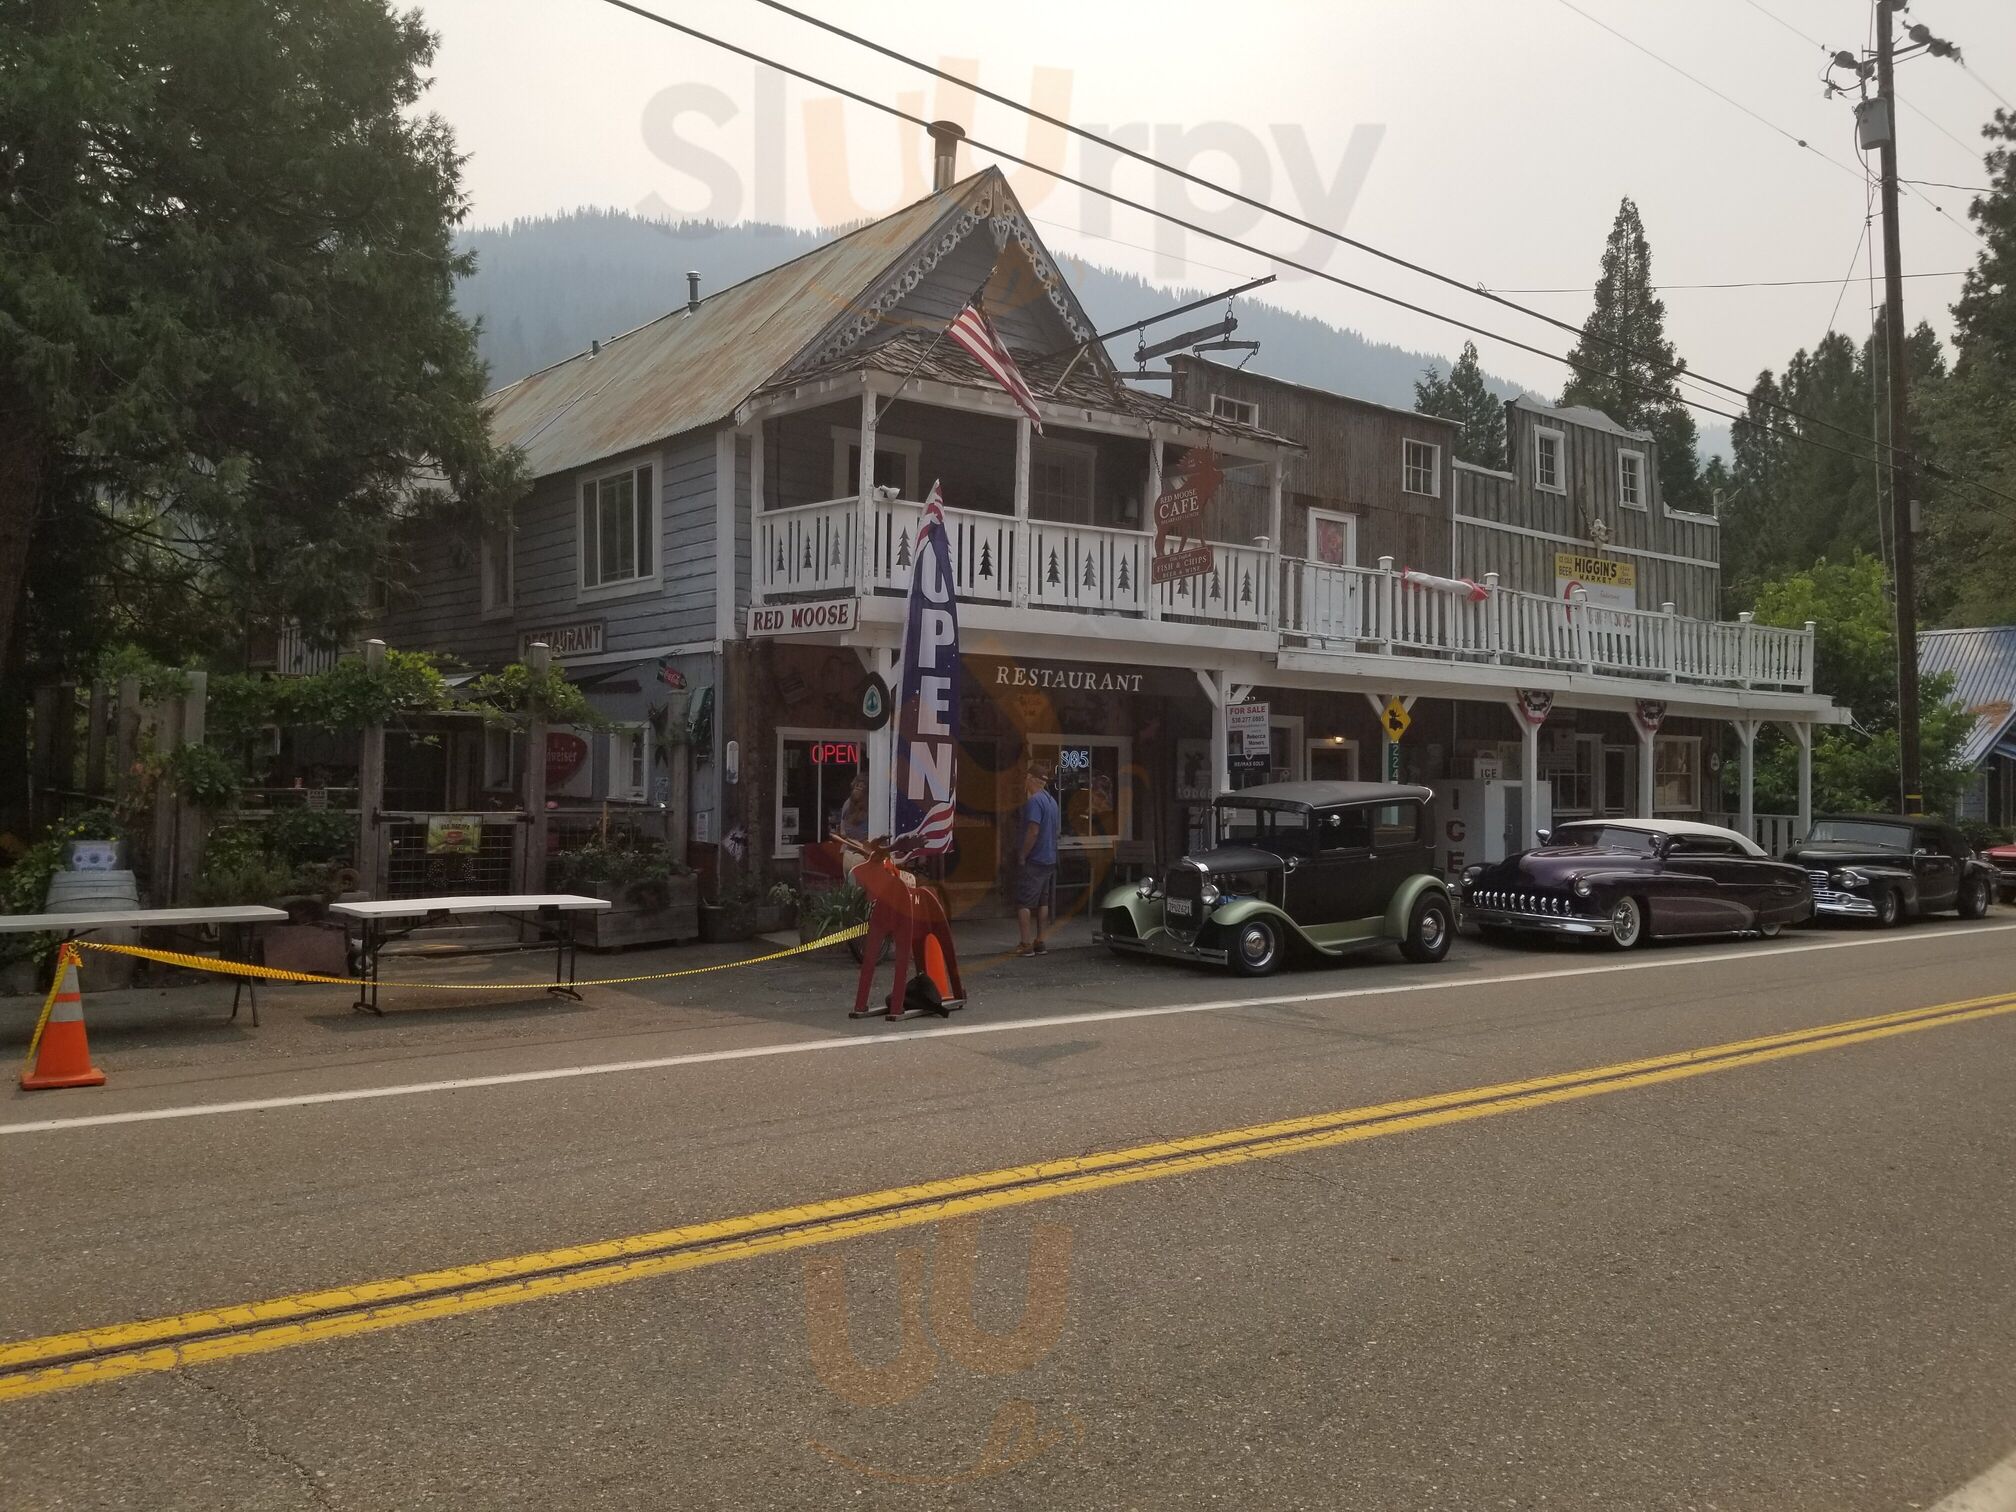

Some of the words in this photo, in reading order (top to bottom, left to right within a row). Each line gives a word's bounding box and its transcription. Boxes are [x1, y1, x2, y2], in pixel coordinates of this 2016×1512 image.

[1160, 495, 1173, 504] RED
[1173, 488, 1197, 501] MOOSE
[1159, 496, 1199, 519] CAFE
[1157, 562, 1173, 573] FISH
[1184, 555, 1207, 567] CHIPS
[1574, 557, 1617, 578] HIGGIN'S
[1580, 574, 1612, 584] MARKET
[753, 611, 784, 630] RED
[791, 604, 849, 628] MOOSE
[907, 541, 956, 803] OPEN
[995, 666, 1144, 692] RESTAURANT
[1230, 707, 1245, 715] FOR
[1247, 706, 1265, 714] SALE
[547, 746, 577, 763] dweiser
[812, 744, 859, 764] OPEN
[1060, 751, 1090, 769] 805
[1481, 768, 1497, 778] ICE
